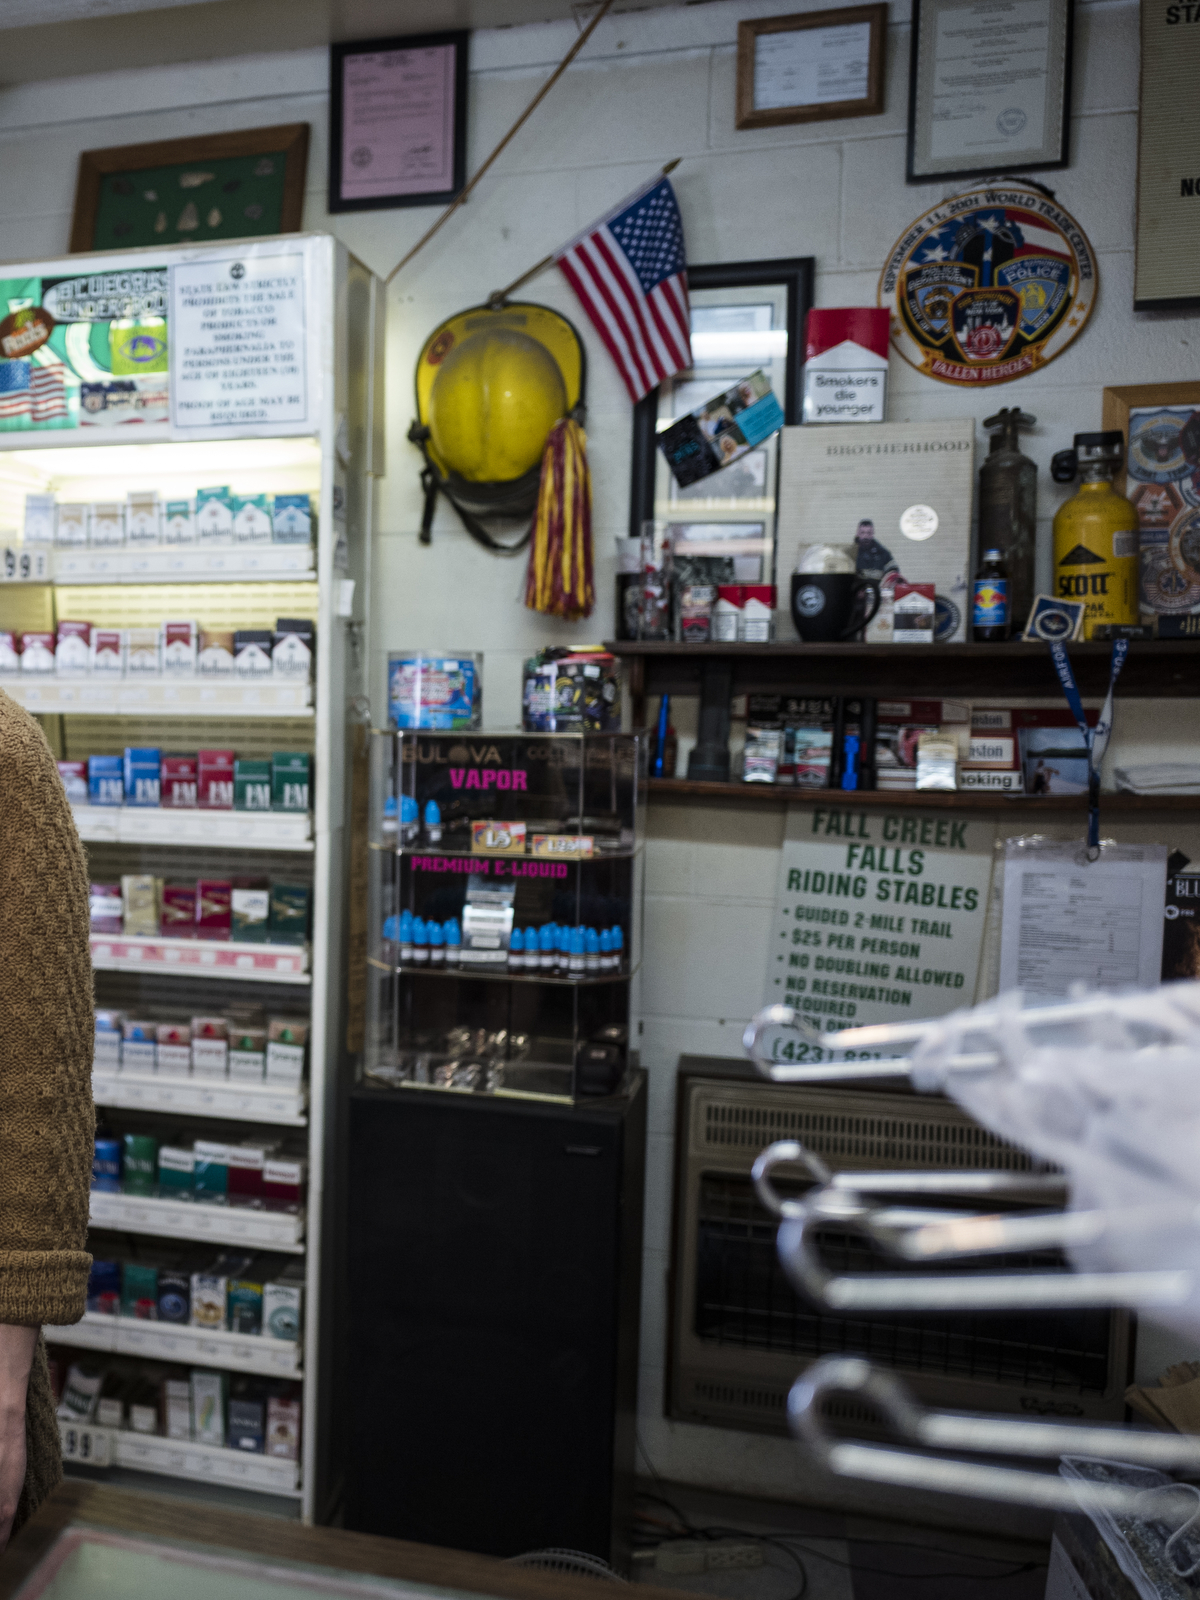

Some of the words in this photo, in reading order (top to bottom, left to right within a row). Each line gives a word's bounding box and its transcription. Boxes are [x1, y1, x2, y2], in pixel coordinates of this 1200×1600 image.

[884, 225, 925, 293] SEPTEMBER
[947, 197, 980, 215] 2001
[984, 192, 1037, 208] WORLD
[1039, 200, 1073, 236] TRADE
[1070, 232, 1093, 281] CENTER
[921, 265, 962, 277] POLICE
[1005, 268, 1062, 283] POLICE
[931, 356, 979, 380] FALLEN
[981, 354, 1034, 379] HEROES
[815, 375, 879, 387] Smokers
[834, 389, 856, 401] die
[816, 403, 875, 416] younger
[826, 440, 970, 455] BROTHERHOOD
[1058, 571, 1111, 597] SCOTT
[449, 768, 529, 791] VAPOR
[812, 807, 870, 838] FALL
[881, 813, 969, 849] CREEK
[410, 856, 490, 875] PREMIUM
[493, 859, 569, 879] E-LIQUID
[846, 843, 925, 876] FALLS
[786, 867, 868, 899] RIDING
[875, 878, 979, 912] STABLES
[795, 905, 849, 926] GUIDED
[853, 911, 905, 934] 2-MILE
[911, 918, 954, 939] TRAIL
[791, 927, 822, 947] $25
[826, 932, 856, 951] PER
[860, 937, 921, 959] PERSON
[788, 951, 810, 969] NO
[814, 955, 890, 979] DOUBLING
[894, 966, 965, 989] ALLOWED
[785, 974, 807, 992] NO
[811, 978, 912, 1006] RESERVATION
